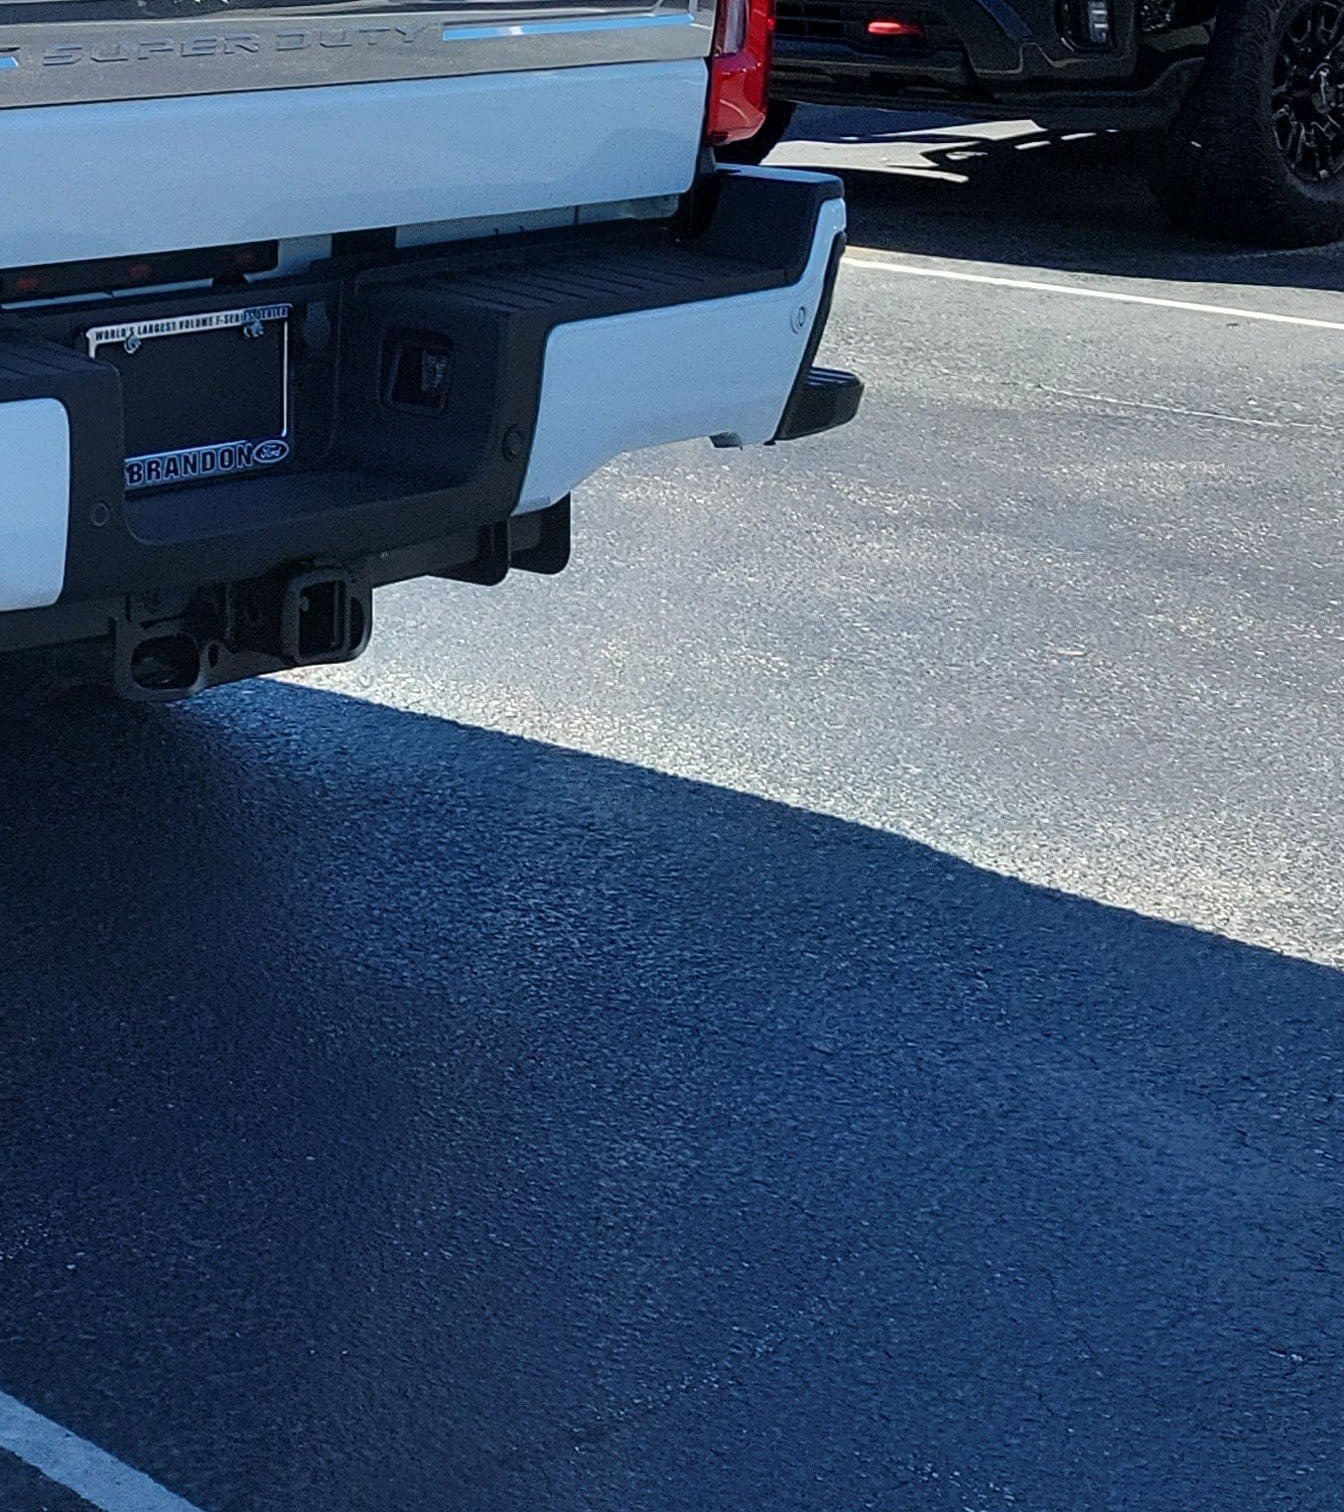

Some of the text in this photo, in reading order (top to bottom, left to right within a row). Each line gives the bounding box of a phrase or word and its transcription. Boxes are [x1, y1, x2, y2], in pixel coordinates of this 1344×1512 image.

[42, 23, 431, 67] SUPER DUTY
[137, 321, 177, 335] LARGEST
[179, 316, 214, 330] VOLUME
[126, 442, 254, 486] BRANDON
